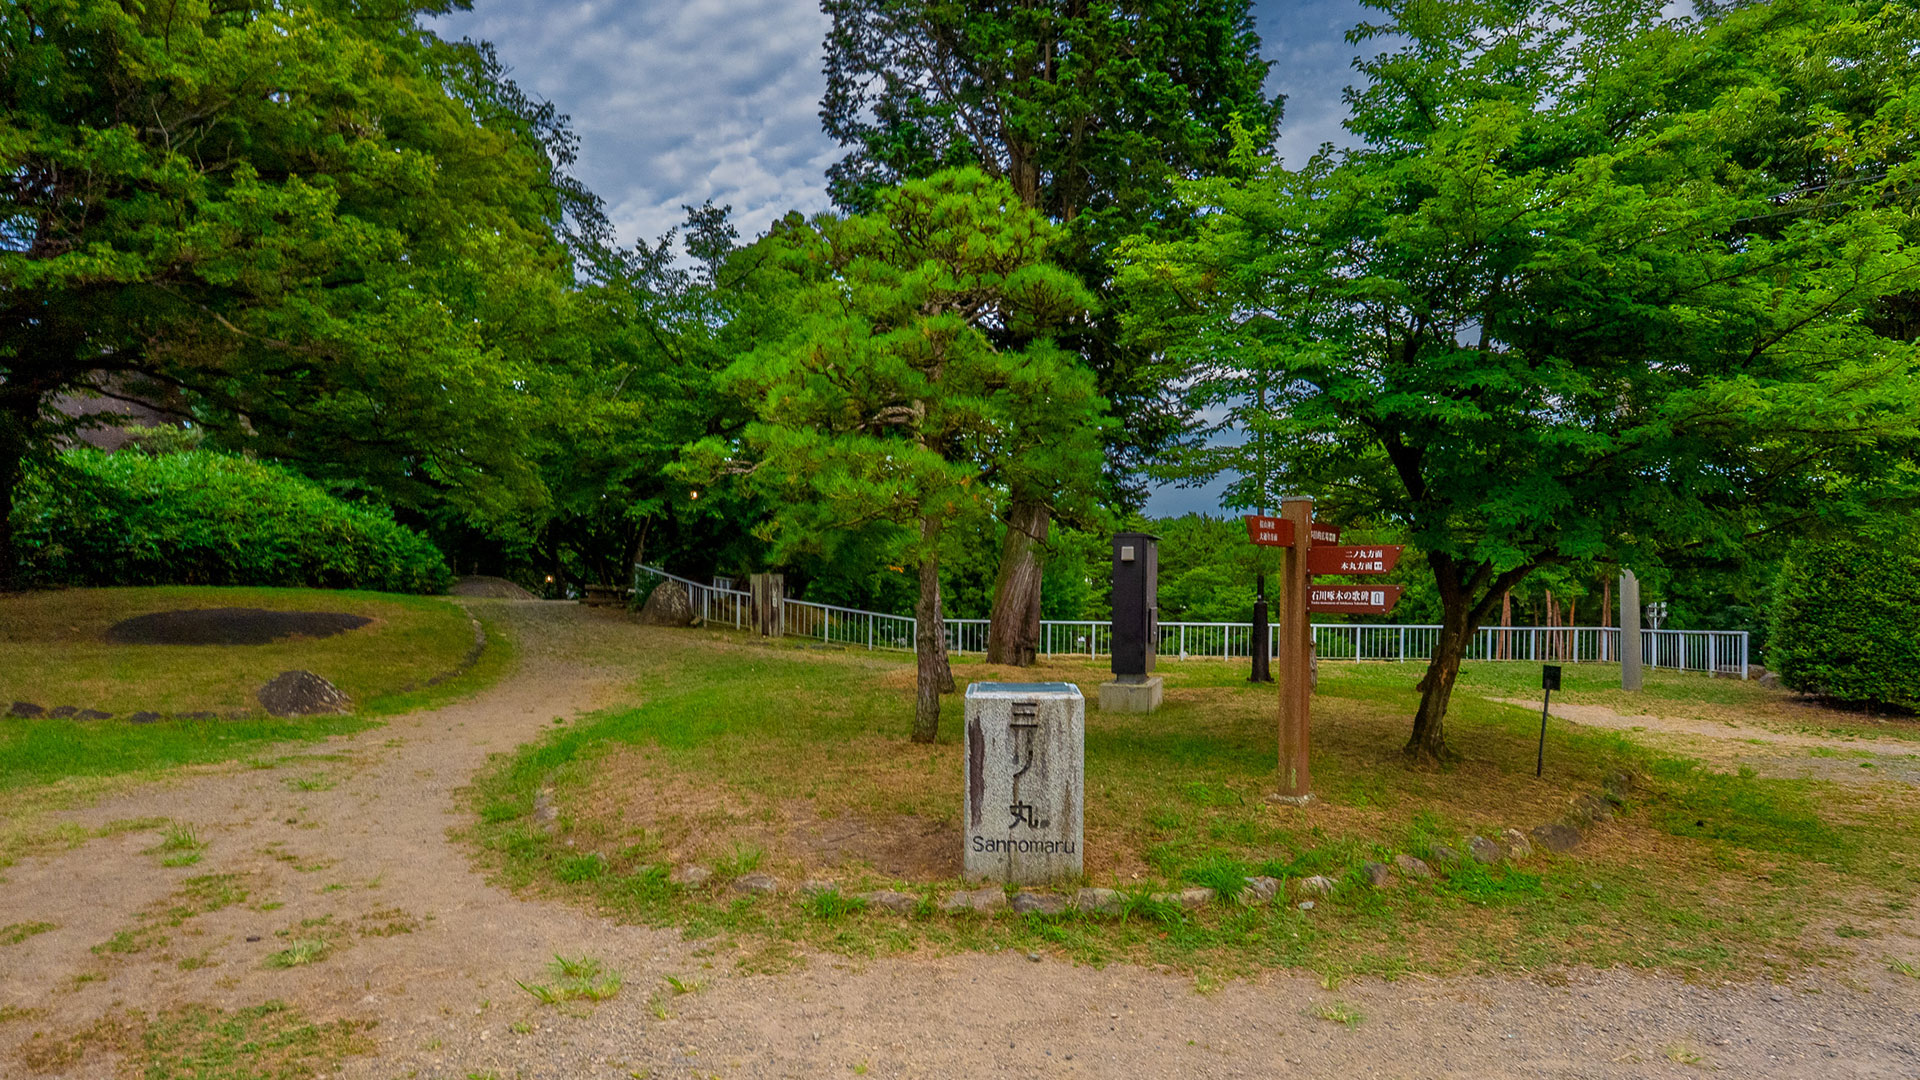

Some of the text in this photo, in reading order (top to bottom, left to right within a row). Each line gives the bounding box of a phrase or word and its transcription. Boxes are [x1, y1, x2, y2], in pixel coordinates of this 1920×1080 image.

[1345, 550, 1382, 558] 二ノ丸方面
[1311, 590, 1369, 601] 石川啄木の歌碑
[1009, 702, 1039, 829] 三ノ丸
[972, 835, 1075, 854] Sannomaru
